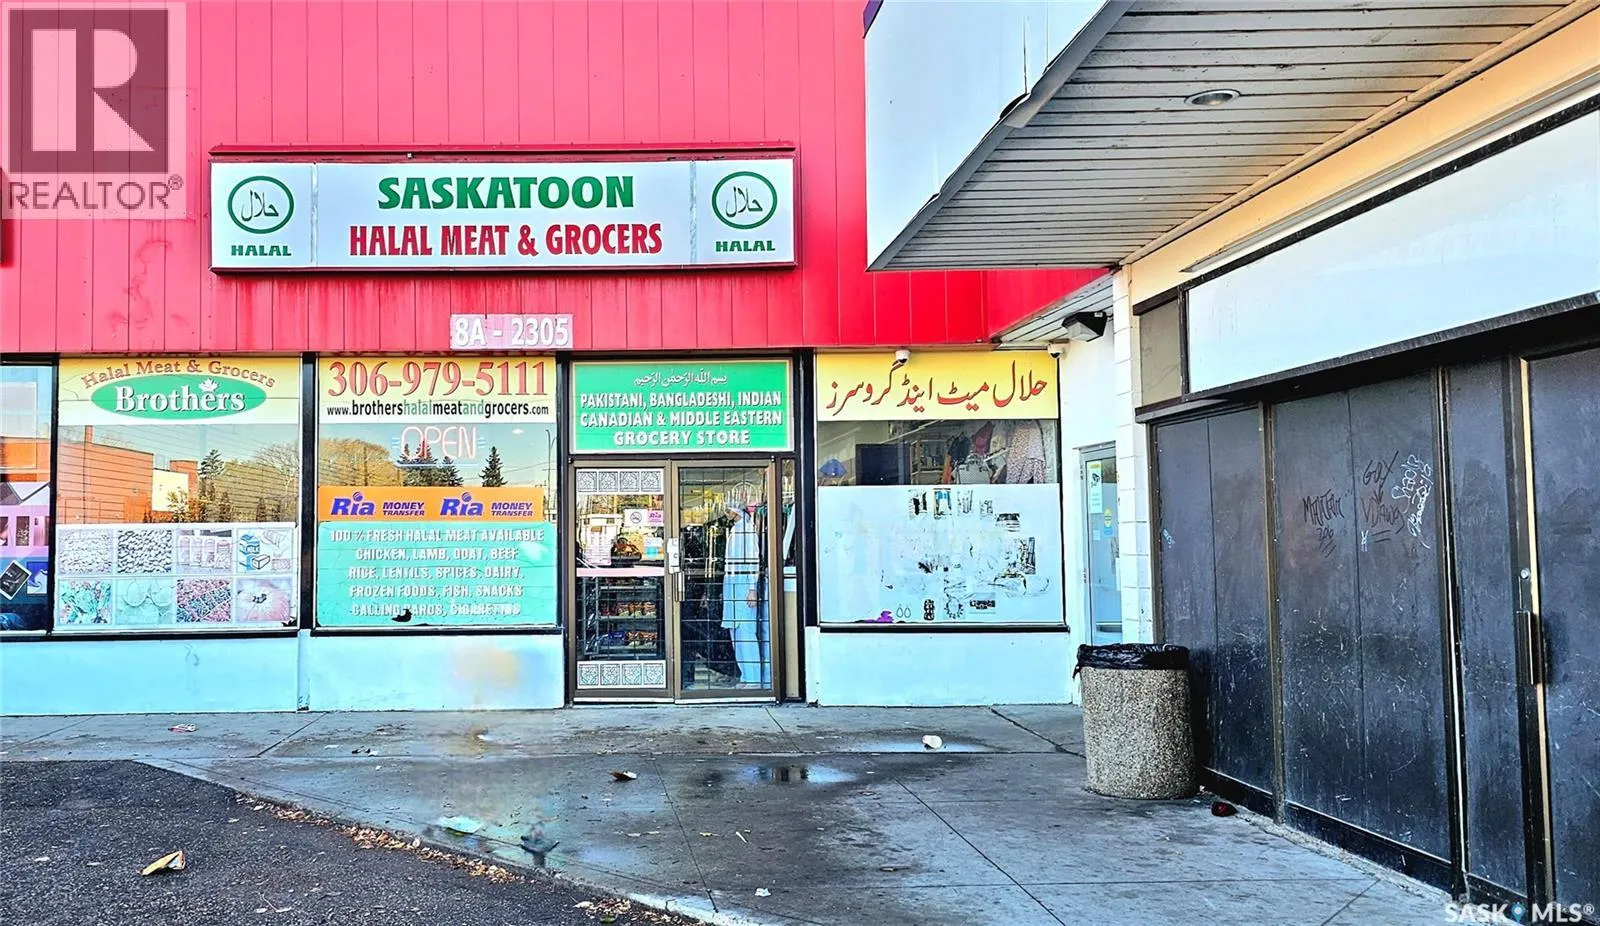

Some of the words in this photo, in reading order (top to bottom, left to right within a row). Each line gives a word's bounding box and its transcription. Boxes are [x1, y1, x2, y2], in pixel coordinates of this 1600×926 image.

[378, 176, 634, 209] SASKATOON
[725, 186, 763, 218] حلال
[241, 189, 279, 222] حلال
[231, 245, 292, 256] HALAL
[350, 225, 432, 256] HALAL
[441, 225, 509, 256] MEAT
[518, 225, 539, 256] &
[546, 223, 662, 255] GROCERS
[715, 240, 776, 252] HALAL
[454, 317, 486, 346] 8A
[511, 317, 569, 346] 2305
[81, 364, 131, 389] Halal
[136, 360, 181, 375] Meat
[186, 359, 202, 373] &
[208, 360, 276, 388] Grocers
[328, 361, 548, 397] 306-979-5111
[993, 360, 1048, 408] حلال
[115, 383, 246, 413] Brothers
[326, 399, 549, 419] www.brothershalalmeatandgrocers.com
[580, 393, 647, 410] PAKISTANI,
[650, 391, 735, 410] BANGLADESHI,
[738, 391, 782, 407] INDIAN
[580, 411, 653, 427] CANADIAN
[656, 411, 667, 426] &
[670, 410, 720, 426] MIDDLE
[724, 410, 783, 425] EASTERN
[401, 425, 478, 460] OPEN
[614, 430, 691, 446] GROCERY
[696, 429, 750, 446] STORE
[331, 492, 375, 516] Ria
[383, 502, 424, 510] MONEY
[440, 492, 484, 516] Ria
[491, 502, 533, 510] MONEY
[366, 529, 402, 542] FRESH
[407, 529, 442, 542] HALAL
[446, 529, 478, 542] MEAT
[481, 528, 545, 541] AVAILABLE
[356, 548, 411, 562] CHICKEN,
[412, 547, 450, 562] LAMB,
[490, 547, 519, 561] BEEF
[348, 566, 381, 580] RICE,
[382, 566, 433, 580] LENTILS,
[435, 566, 481, 580] SPICES,
[484, 566, 525, 580] DAIRY,
[350, 585, 394, 597] FROZEN
[399, 585, 442, 598] FOODS,
[444, 584, 473, 598] FISH,
[476, 584, 524, 597] SNACKS
